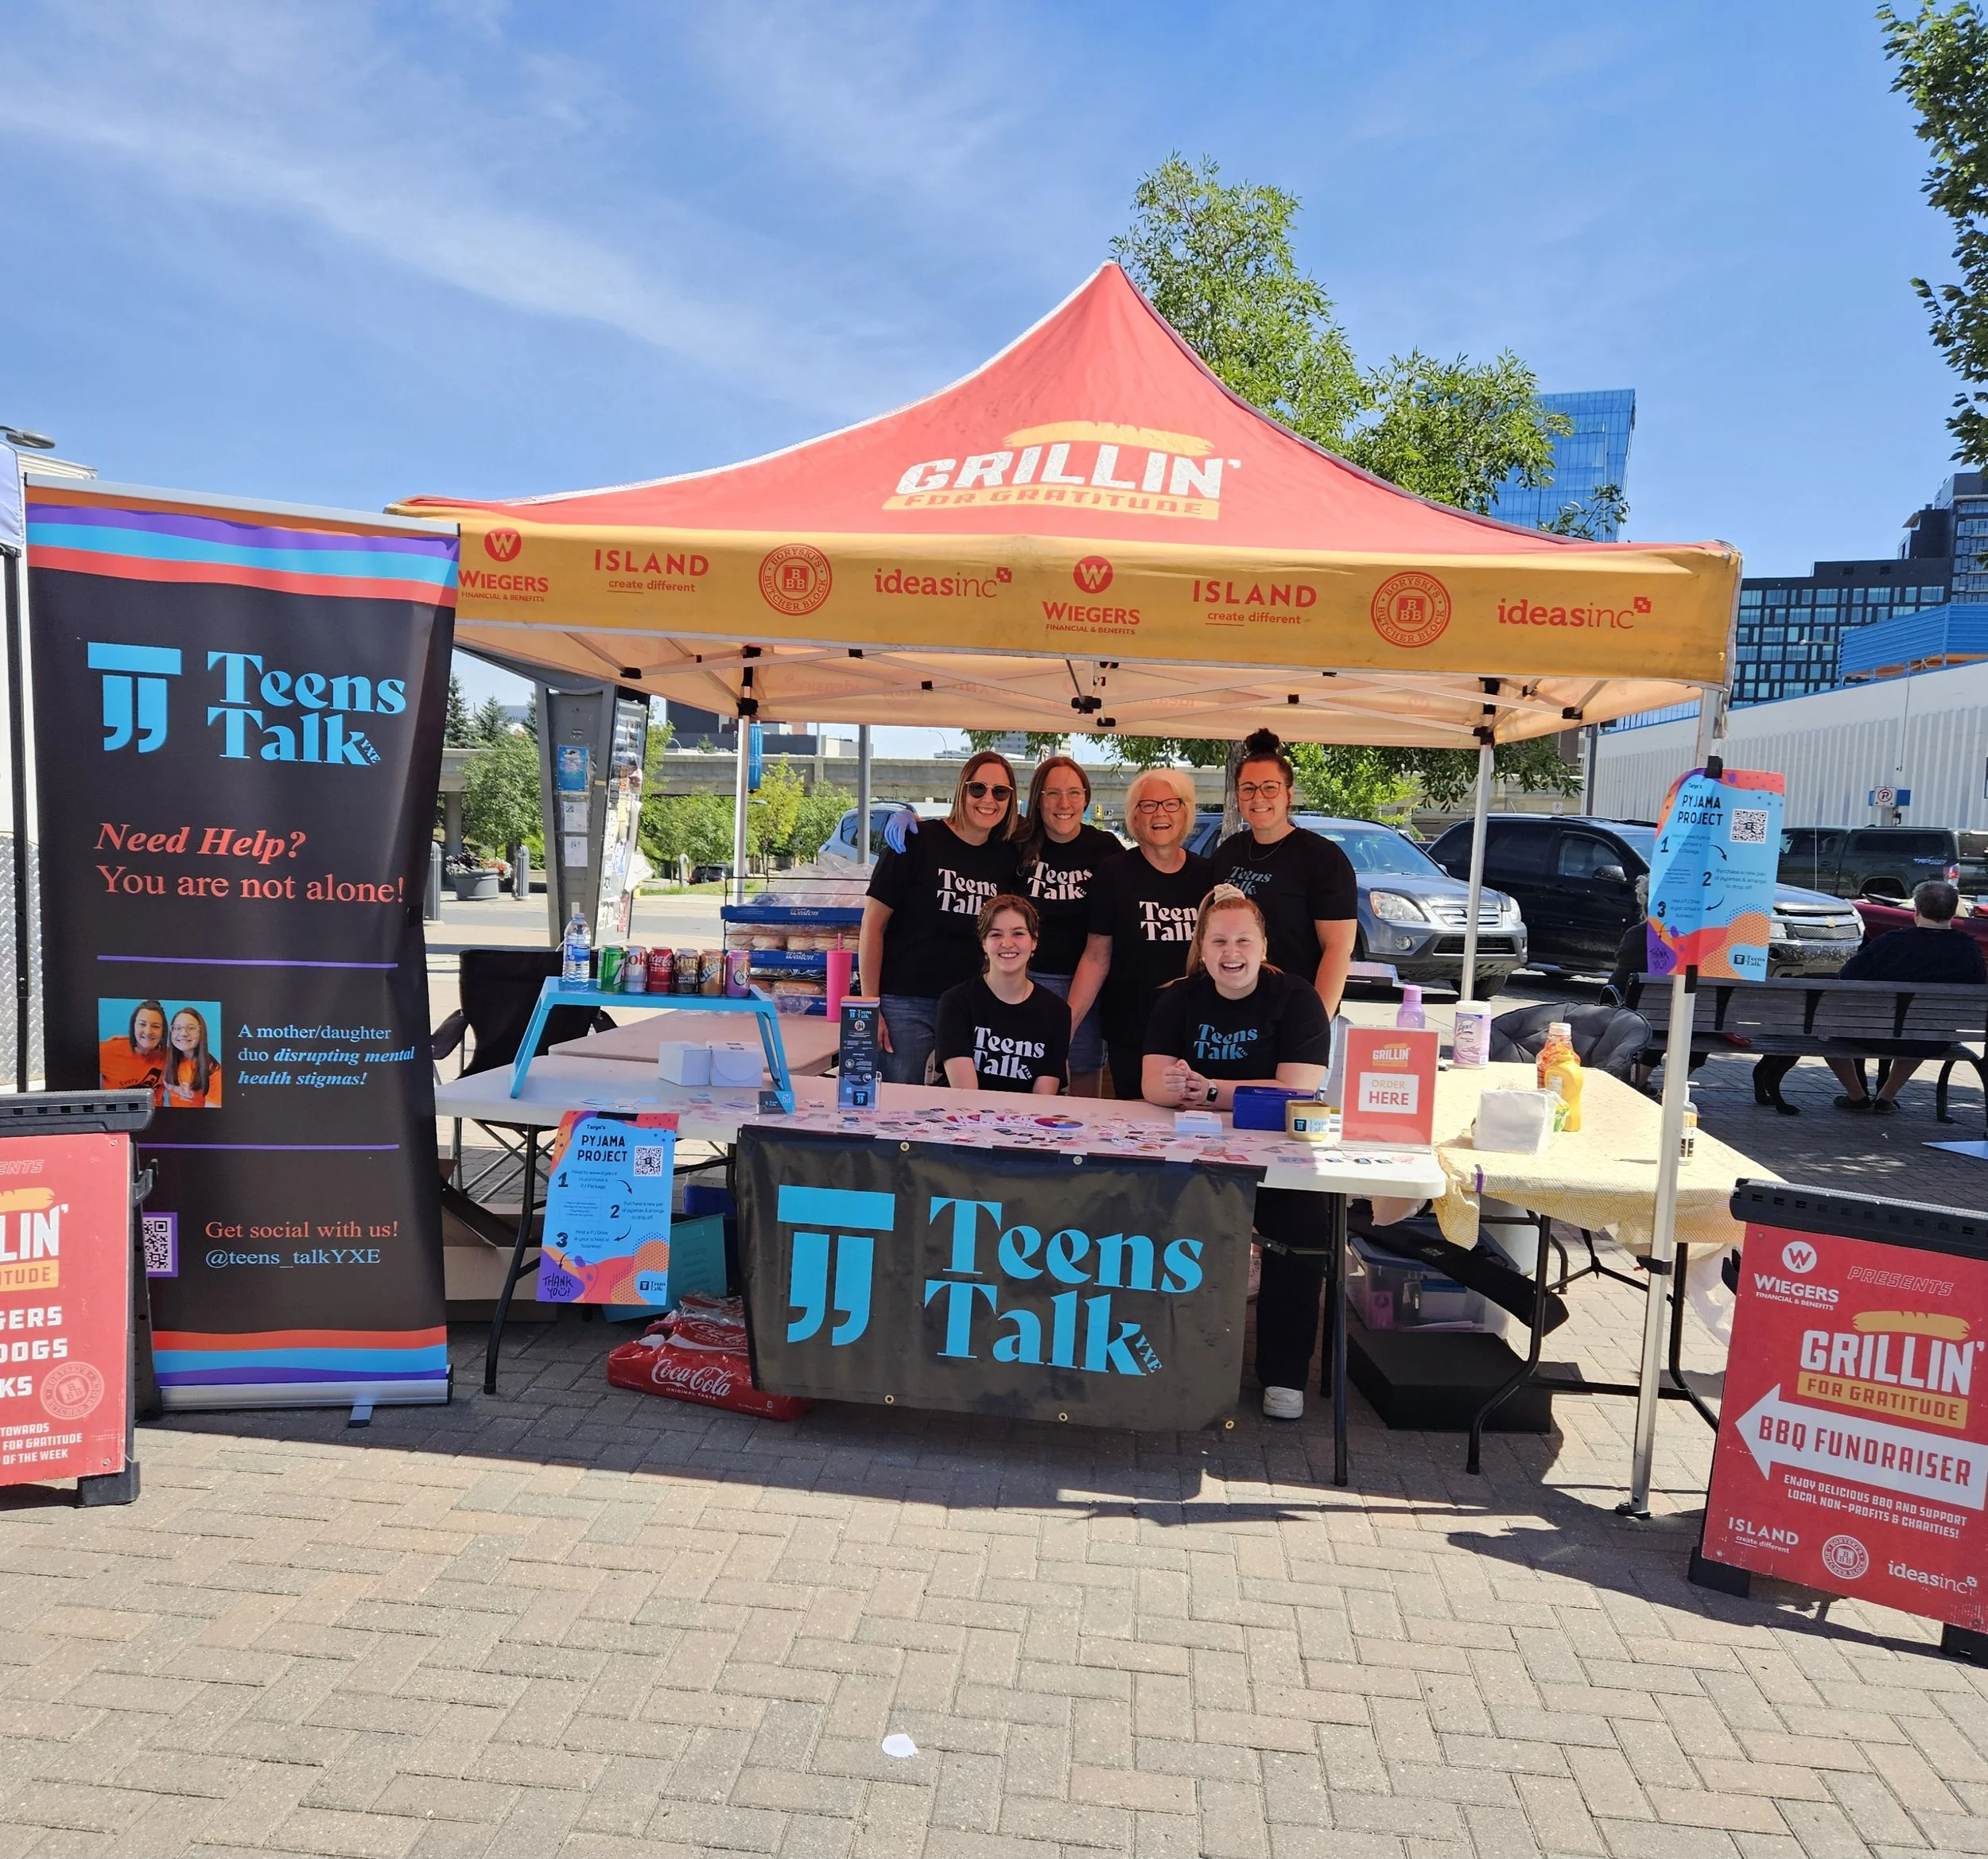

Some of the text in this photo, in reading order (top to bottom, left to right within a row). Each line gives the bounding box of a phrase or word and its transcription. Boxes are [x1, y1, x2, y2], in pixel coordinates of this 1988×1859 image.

[895, 443, 1241, 499] GRILLIN'
[903, 489, 1204, 515] FOR GRATITUDE
[594, 549, 710, 577] ISLAND
[459, 570, 549, 592] WIEGERS
[608, 580, 696, 592] create different
[874, 567, 997, 598] ideasinc
[460, 591, 501, 600] FINANCIAL
[510, 594, 546, 603] BENEFITS
[764, 575, 826, 611] BUTCHER BLOCK
[1193, 580, 1318, 607] ISLAND
[1041, 600, 1140, 625] WIEGERS
[1207, 611, 1301, 624] create different
[1497, 598, 1634, 630] ideasinc
[1046, 623, 1089, 633] FINANCIAL
[1098, 627, 1136, 635] BENEFITS
[1377, 606, 1445, 642] BUTCHER BLOCK
[207, 650, 406, 714] Teens
[207, 706, 371, 766] Talk
[1682, 794, 1721, 809] PYJAMA
[1677, 811, 1723, 826] PROJECT
[93, 822, 306, 864] Need Help?
[1660, 836, 1669, 853] 1
[938, 867, 997, 897] Teens
[1031, 860, 1093, 884] Teens
[1702, 871, 1713, 887] 2
[95, 865, 405, 903] You are not alone!
[1027, 877, 1085, 900] Talk
[790, 907, 820, 916] Weston
[1139, 901, 1198, 922] Teen
[1657, 901, 1667, 918] 3
[786, 951, 814, 961] Weston
[238, 1024, 392, 1042] A mother/daughter
[973, 1026, 1046, 1058] Teens
[1198, 1023, 1258, 1045] Teens
[238, 1046, 415, 1065] duo disrupting mental
[1194, 1041, 1244, 1060] Talk
[973, 1049, 1028, 1080] Talk
[238, 1071, 367, 1089] health stigmas!
[1371, 1079, 1406, 1089] ORDER
[1369, 1091, 1409, 1106] HERE
[581, 1135, 625, 1147] PYJAMA
[577, 1150, 627, 1162] PROJECT
[558, 1171, 569, 1187] 1
[610, 1205, 620, 1219] 2
[205, 1221, 398, 1238] Get social with us!
[556, 1232, 569, 1248] 3
[930, 1196, 1204, 1294] Teens
[205, 1249, 381, 1269] @teens_talkYXE
[542, 1273, 574, 1288] THANK
[1753, 1272, 1839, 1303] WIEGERS
[1847, 1266, 1954, 1297] PRESENTS
[1756, 1291, 1793, 1304] FINANCIAL
[1801, 1299, 1835, 1310] BENEFITS
[924, 1279, 1147, 1377] Talk
[1135, 1334, 1163, 1373] YXE
[1800, 1329, 1986, 1395] GRILLIN'
[697, 1391, 716, 1401] TASTE
[1807, 1378, 1959, 1421] FOR GRATITUDE
[2, 1433, 83, 1451] FOR GRATITUDE
[1758, 1415, 1971, 1487] BBQ FUNDRAISER
[2, 1448, 69, 1465] OF THE WEEK
[1784, 1474, 1968, 1527] ENJOY DELICIOUS BBQ AND SUPPORT
[1787, 1488, 1959, 1539] LOCAL NON-PROFITS & CHARITIES!
[1727, 1516, 1800, 1547] ISLAND
[1736, 1535, 1790, 1554] create different
[1888, 1560, 1967, 1594] ideasinc
